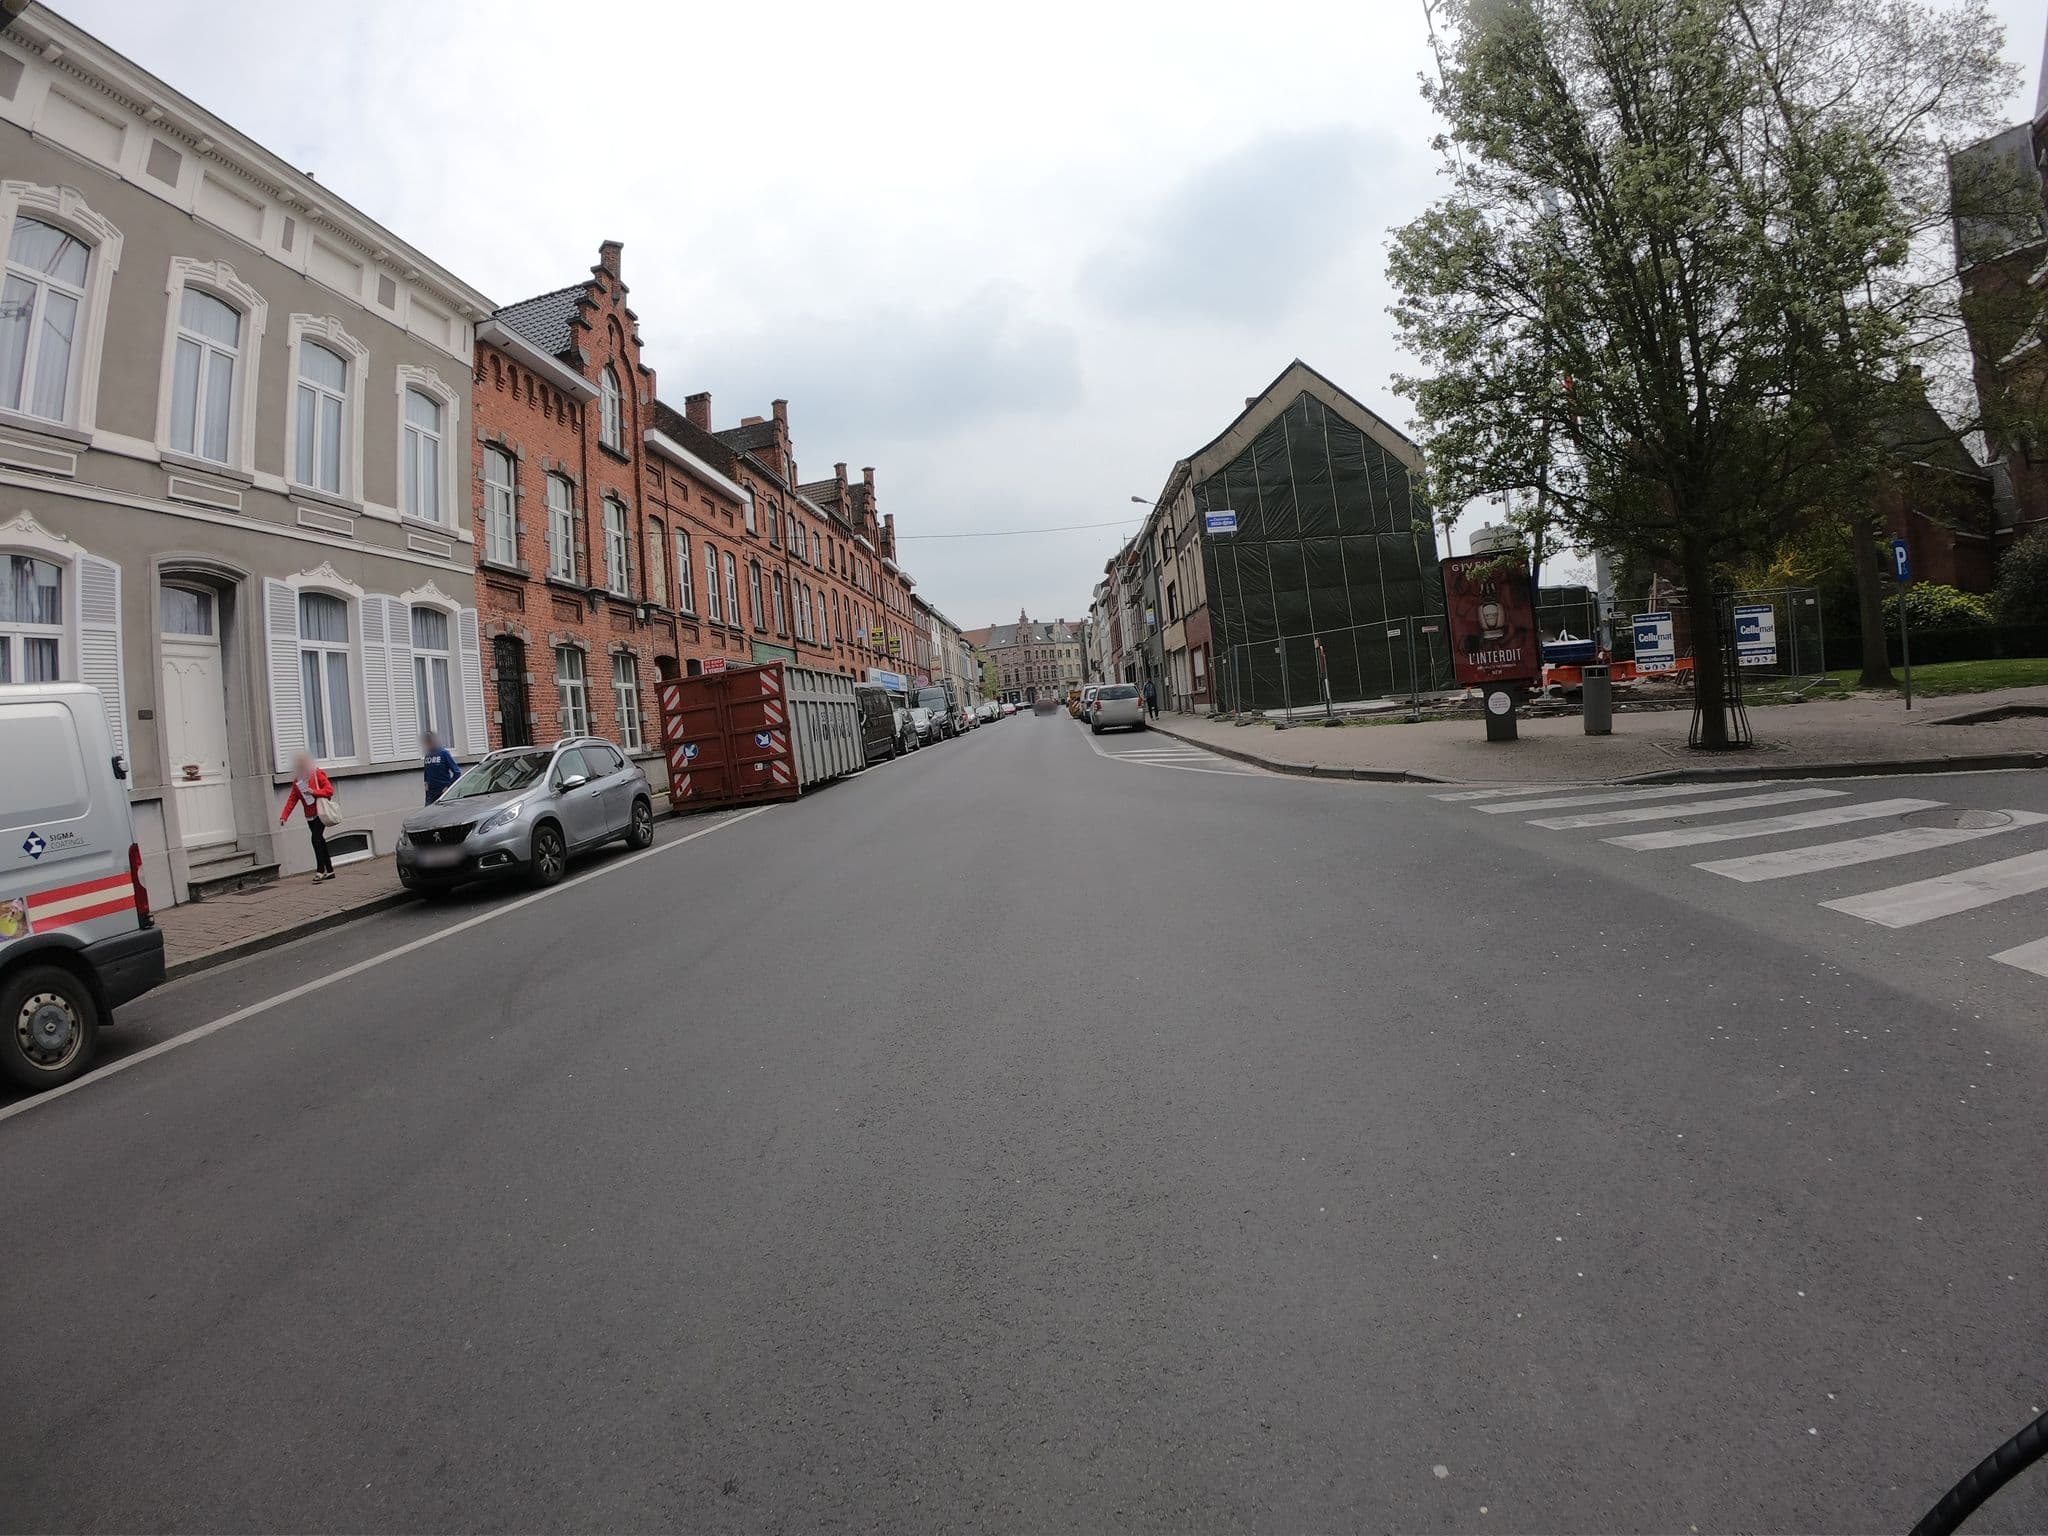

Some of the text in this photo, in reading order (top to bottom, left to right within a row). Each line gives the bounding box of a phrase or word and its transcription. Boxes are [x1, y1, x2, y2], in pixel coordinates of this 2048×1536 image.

[1895, 546, 1907, 575] P
[1468, 648, 1521, 665] L'INTERDIT
[49, 832, 74, 841] SIGMA
